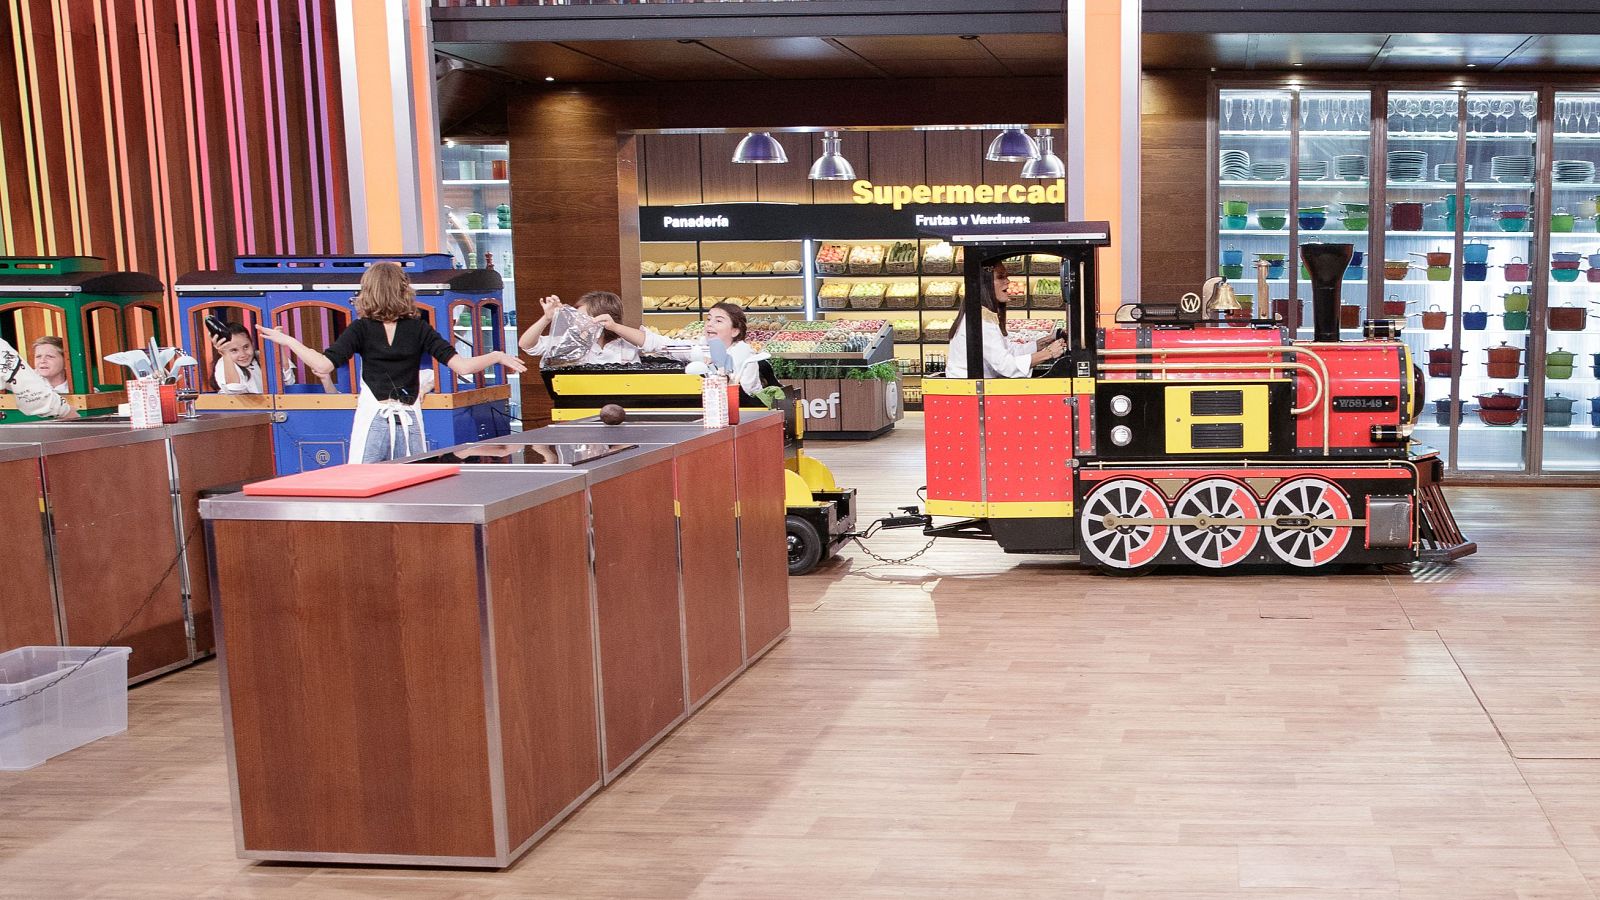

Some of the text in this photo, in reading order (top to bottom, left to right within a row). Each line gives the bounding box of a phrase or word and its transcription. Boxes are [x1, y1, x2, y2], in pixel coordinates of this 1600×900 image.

[663, 214, 729, 228] Panadería
[915, 214, 958, 226] Frutas
[970, 213, 1031, 225] Verduras
[1182, 294, 1199, 312] W
